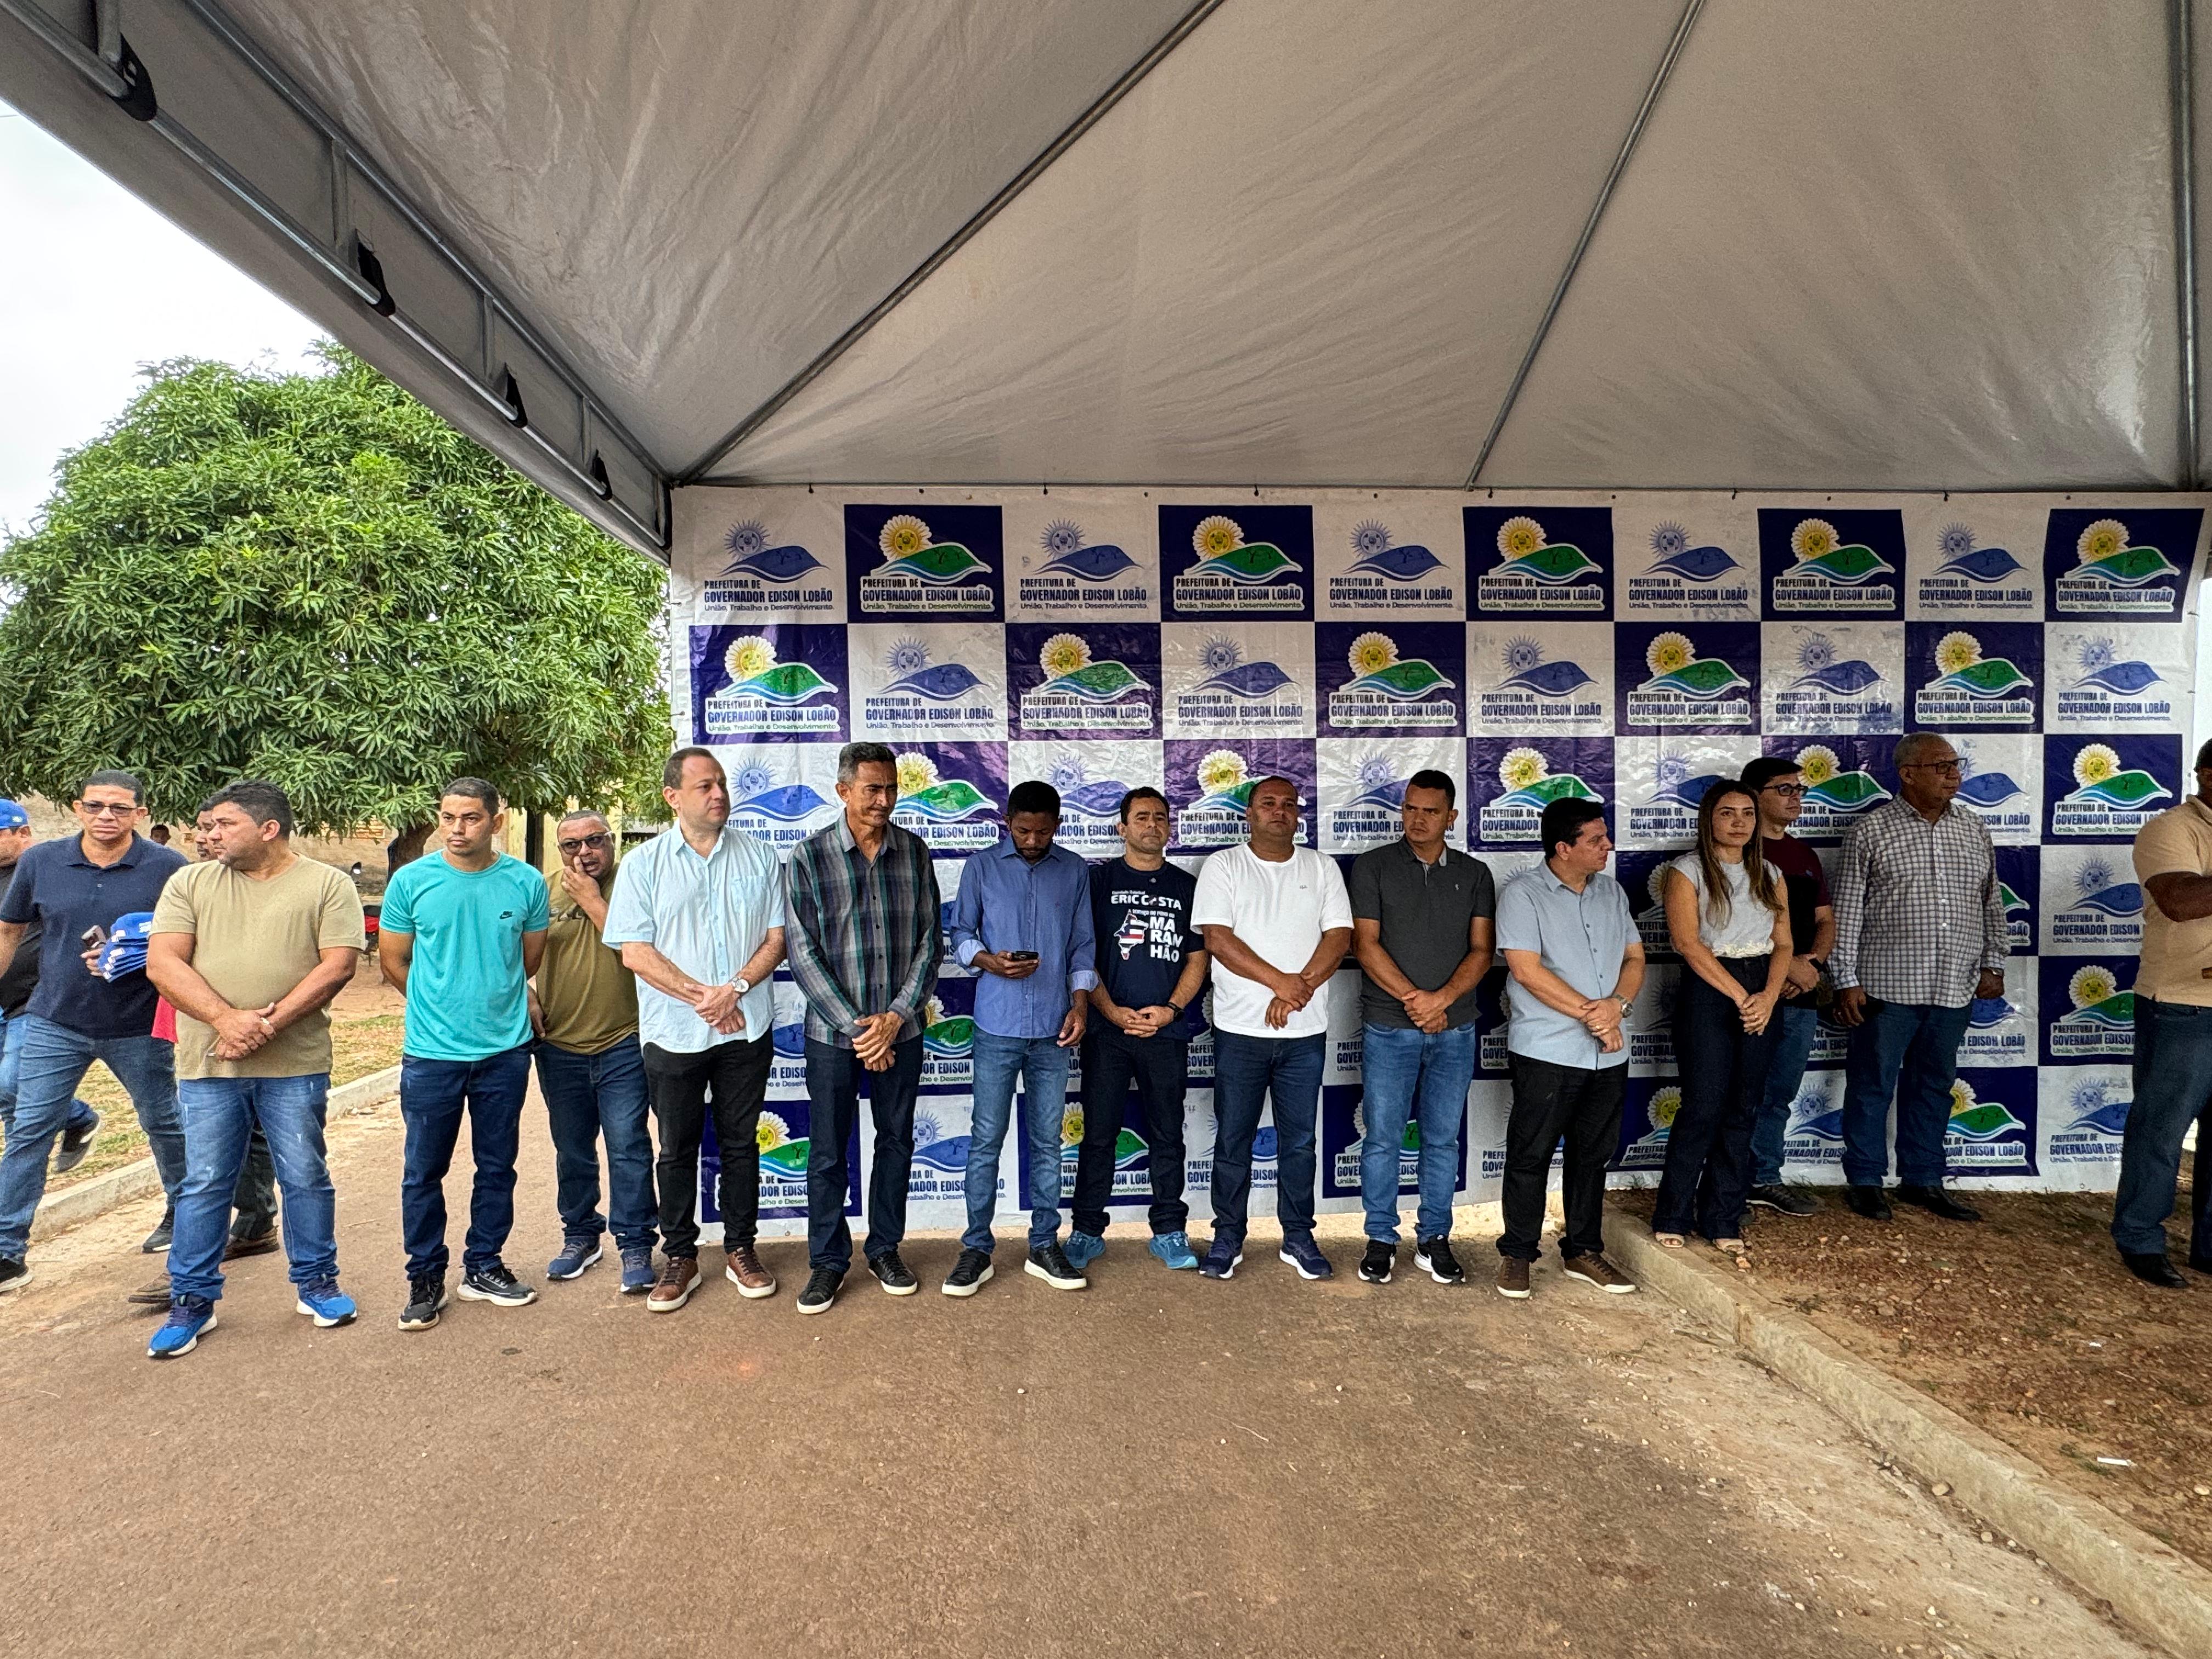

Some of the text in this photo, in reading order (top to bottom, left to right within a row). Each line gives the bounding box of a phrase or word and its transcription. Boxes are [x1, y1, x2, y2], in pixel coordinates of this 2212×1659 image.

[705, 580, 760, 589] PREFEITURA DE
[863, 579, 918, 587] PREFEITURA DE
[1020, 579, 1075, 587] PREFEITURA DE
[1176, 578, 1230, 586] PREFEITURA DE
[1330, 578, 1383, 586] PREFEITURA DE
[1776, 579, 1827, 587] PREFEITURA DE
[1920, 579, 1968, 587] PREFEITURA DE
[705, 588, 832, 602] GOVERNADOR EDISON LOBÃO
[863, 587, 990, 601] GOVERNADOR EDISON LOBÃO
[1020, 587, 1146, 600] GOVERNADOR EDISON LOBÃO
[1176, 586, 1300, 600] GOVERNADOR EDISON LOBÃO
[1330, 586, 1452, 600] GOVERNADOR EDISON LOBÃO
[1481, 586, 1600, 600] GOVERNADOR EDISON LOBÃO
[1629, 587, 1747, 600] GOVERNADOR EDISON LOBÃO
[1776, 587, 1892, 600] GOVERNADOR EDISON LOBÃO
[1920, 588, 2032, 601] GOVERNADOR EDISON LOBÃO
[2058, 589, 2172, 602] GOVERNADOR EDISON LOBÃO
[708, 699, 763, 709] PREFEITURA DE
[866, 698, 922, 706] PREFEITURA DE
[1023, 697, 1078, 705] PREFEITURA DE
[1178, 696, 1233, 704] PREFEITURA DE
[1482, 694, 1534, 702] PREFEITURA DE
[866, 706, 993, 720] GOVERNADOR EDISON LOBÃO
[1178, 704, 1302, 717] GOVERNADOR EDISON LOBÃO
[1331, 703, 1453, 716] GOVERNADOR EDISON LOBÃO
[1482, 702, 1601, 715] GOVERNADOR EDISON LOBÃO
[1630, 701, 1747, 715] GOVERNADOR EDISON LOBÃO
[1776, 703, 1831, 714] GOVERNADOR
[1833, 703, 1861, 714] EDISON
[1918, 701, 2030, 713] GOVERNADOR EDISON LOBÃO
[2058, 701, 2170, 713] GOVERNADOR EDISON LOBÃO
[708, 707, 836, 723] GOVERNADOR EDISON LOBÃO
[1023, 708, 1082, 719] GOVERNADOR
[1086, 708, 1117, 719] EDISON
[1483, 809, 1523, 817] PREFEITURA
[1631, 808, 1683, 816] PREFEITURA DE
[2057, 804, 2095, 812] PREFEITURA
[1181, 812, 1223, 821] PREFEITURA
[1334, 811, 1375, 819] PREFEITURA
[2004, 812, 2030, 825] LOBÃO
[2056, 814, 2141, 825] GOVERNADOR EDISON
[1181, 823, 1238, 834] GOVERNADOR
[1334, 821, 1390, 833] GOVERNADOR
[1483, 820, 1538, 831] GOVERNADOR
[1630, 818, 1686, 829] GOVERNADOR
[774, 830, 806, 841] EDISON
[933, 824, 996, 838] EDISON LOBÃO
[1111, 895, 1139, 904] ERIC
[1150, 916, 1175, 933] MA
[2053, 924, 2140, 935] GOVERNADOR EDISON
[1150, 929, 1184, 947] RAN
[1150, 944, 1180, 963] HÃO
[1967, 1034, 2025, 1046] EDISON LOBÃO
[938, 1062, 969, 1074] EDISON
[1965, 1143, 2023, 1156] EDISON LOBÃO
